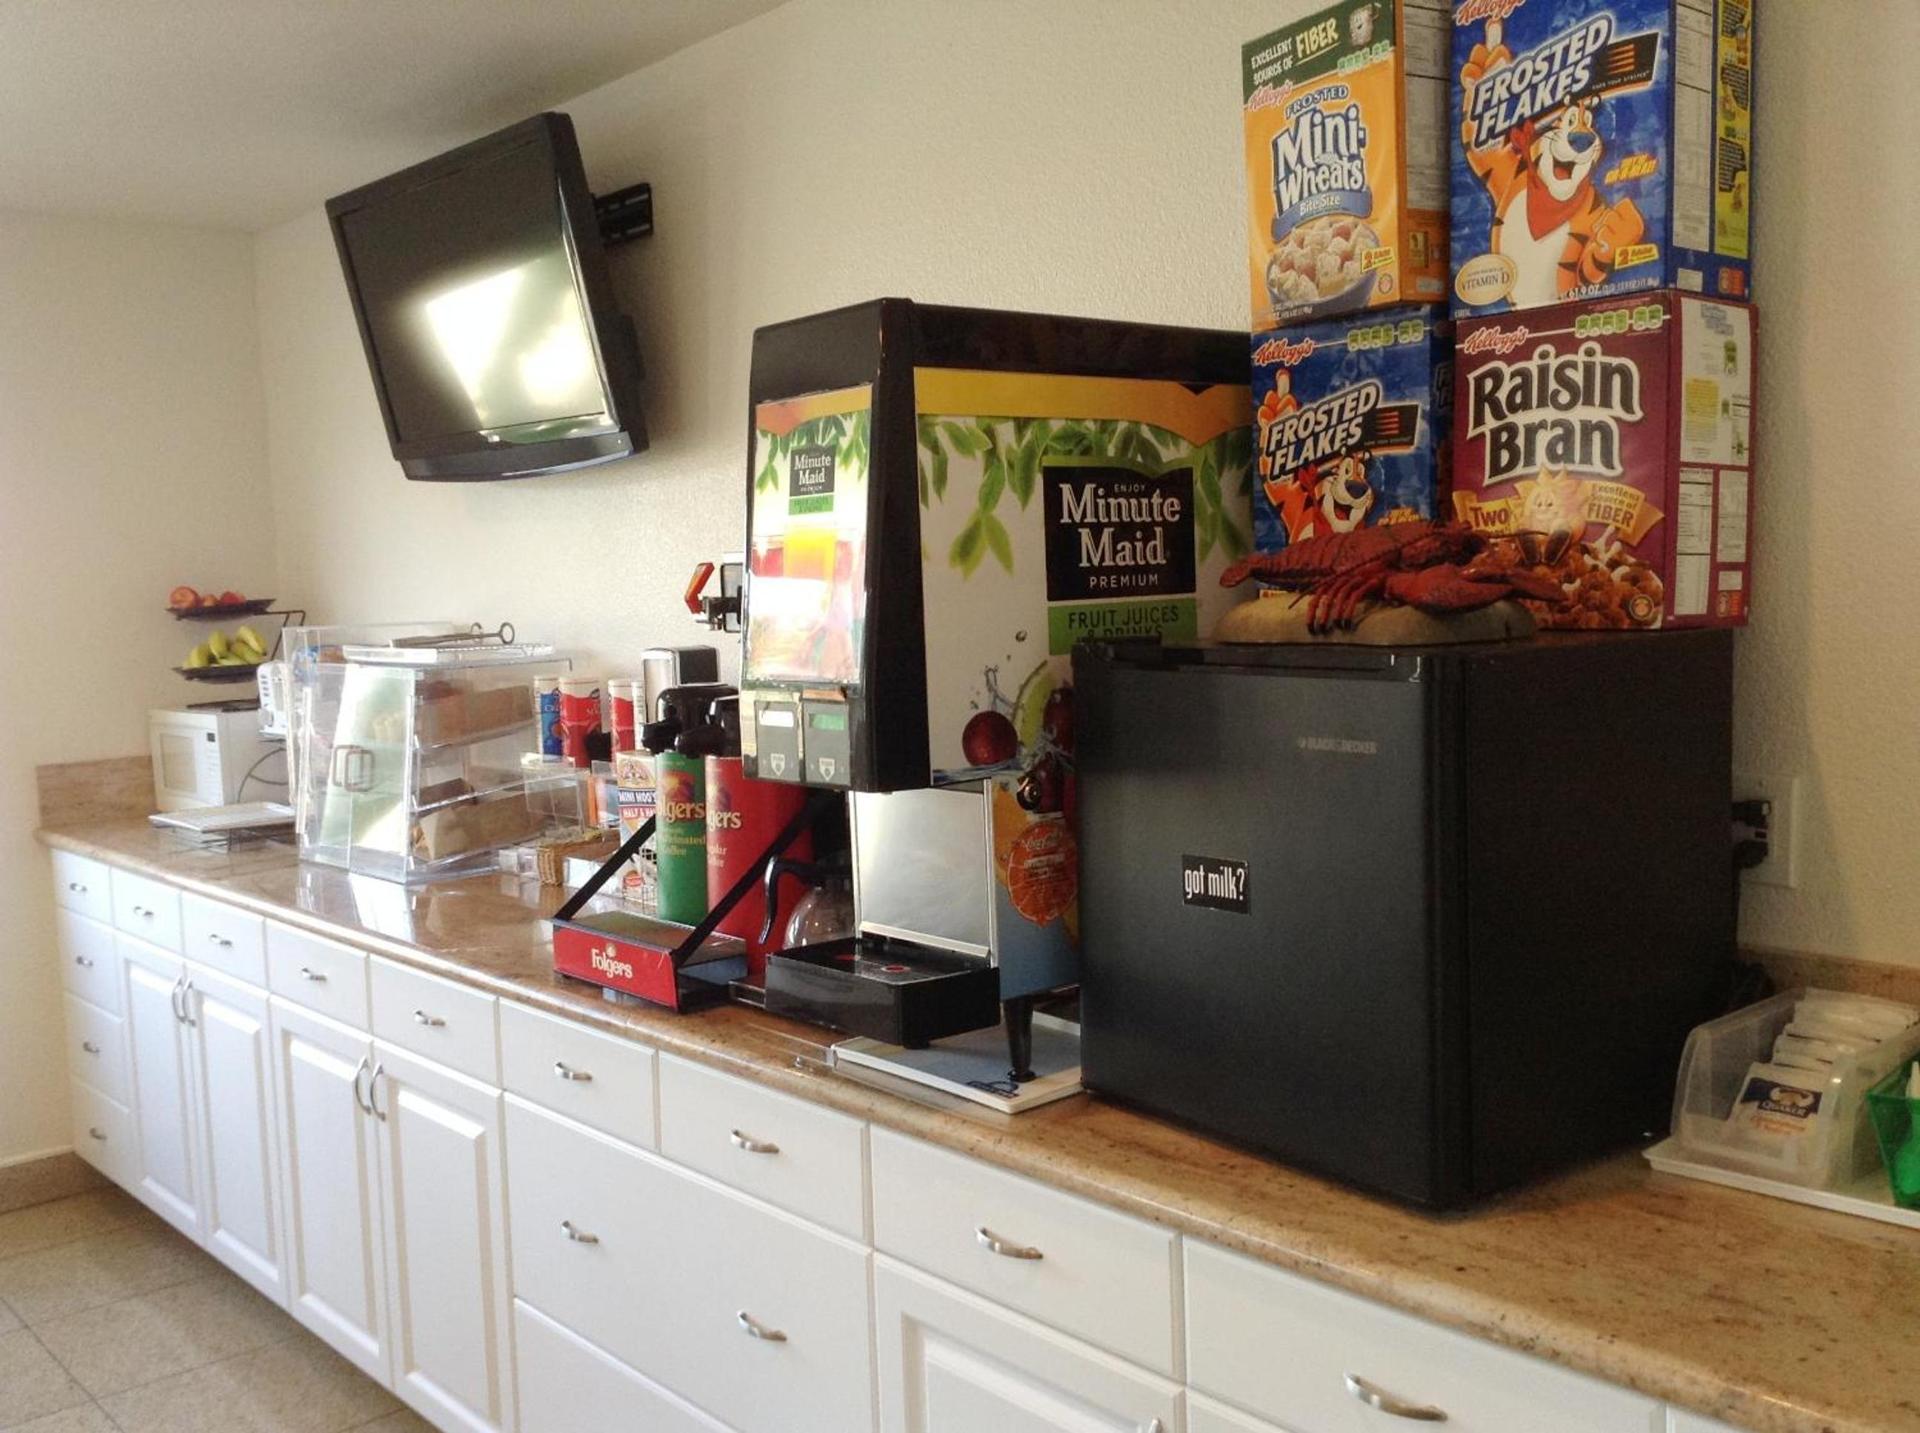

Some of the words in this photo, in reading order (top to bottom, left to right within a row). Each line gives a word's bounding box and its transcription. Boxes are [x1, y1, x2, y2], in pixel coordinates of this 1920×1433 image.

[1251, 38, 1293, 69] EXCELLENT
[1295, 18, 1339, 58] FIBER
[1253, 64, 1283, 86] SOURCE
[1283, 56, 1294, 71] OF
[1475, 18, 1609, 116] FROSTED
[1286, 85, 1349, 117] FROSTED
[1478, 56, 1592, 143] FLAKES
[1278, 158, 1364, 213] Wheats
[1501, 271, 1511, 284] D
[1254, 337, 1316, 366] Kellogg's
[1464, 326, 1529, 354] Kellogg's
[1470, 343, 1641, 432] Raisin
[1270, 385, 1378, 453] FROSTED
[794, 454, 832, 470] Minute
[1272, 416, 1364, 478] FLAKES
[1486, 417, 1620, 482] Bran
[798, 467, 826, 485] Maid
[1114, 483, 1146, 494] ENJOY
[1059, 483, 1182, 524] Minute
[1587, 503, 1634, 528] FIBER
[1078, 526, 1167, 568] Maid
[1089, 574, 1159, 589] PREMIUM
[1068, 609, 1117, 630] FRUIT
[1122, 605, 1180, 625] JUICES
[707, 808, 742, 832] gers
[1184, 864, 1205, 899] got
[1208, 866, 1245, 901] milk?
[591, 947, 633, 979] Folgers
